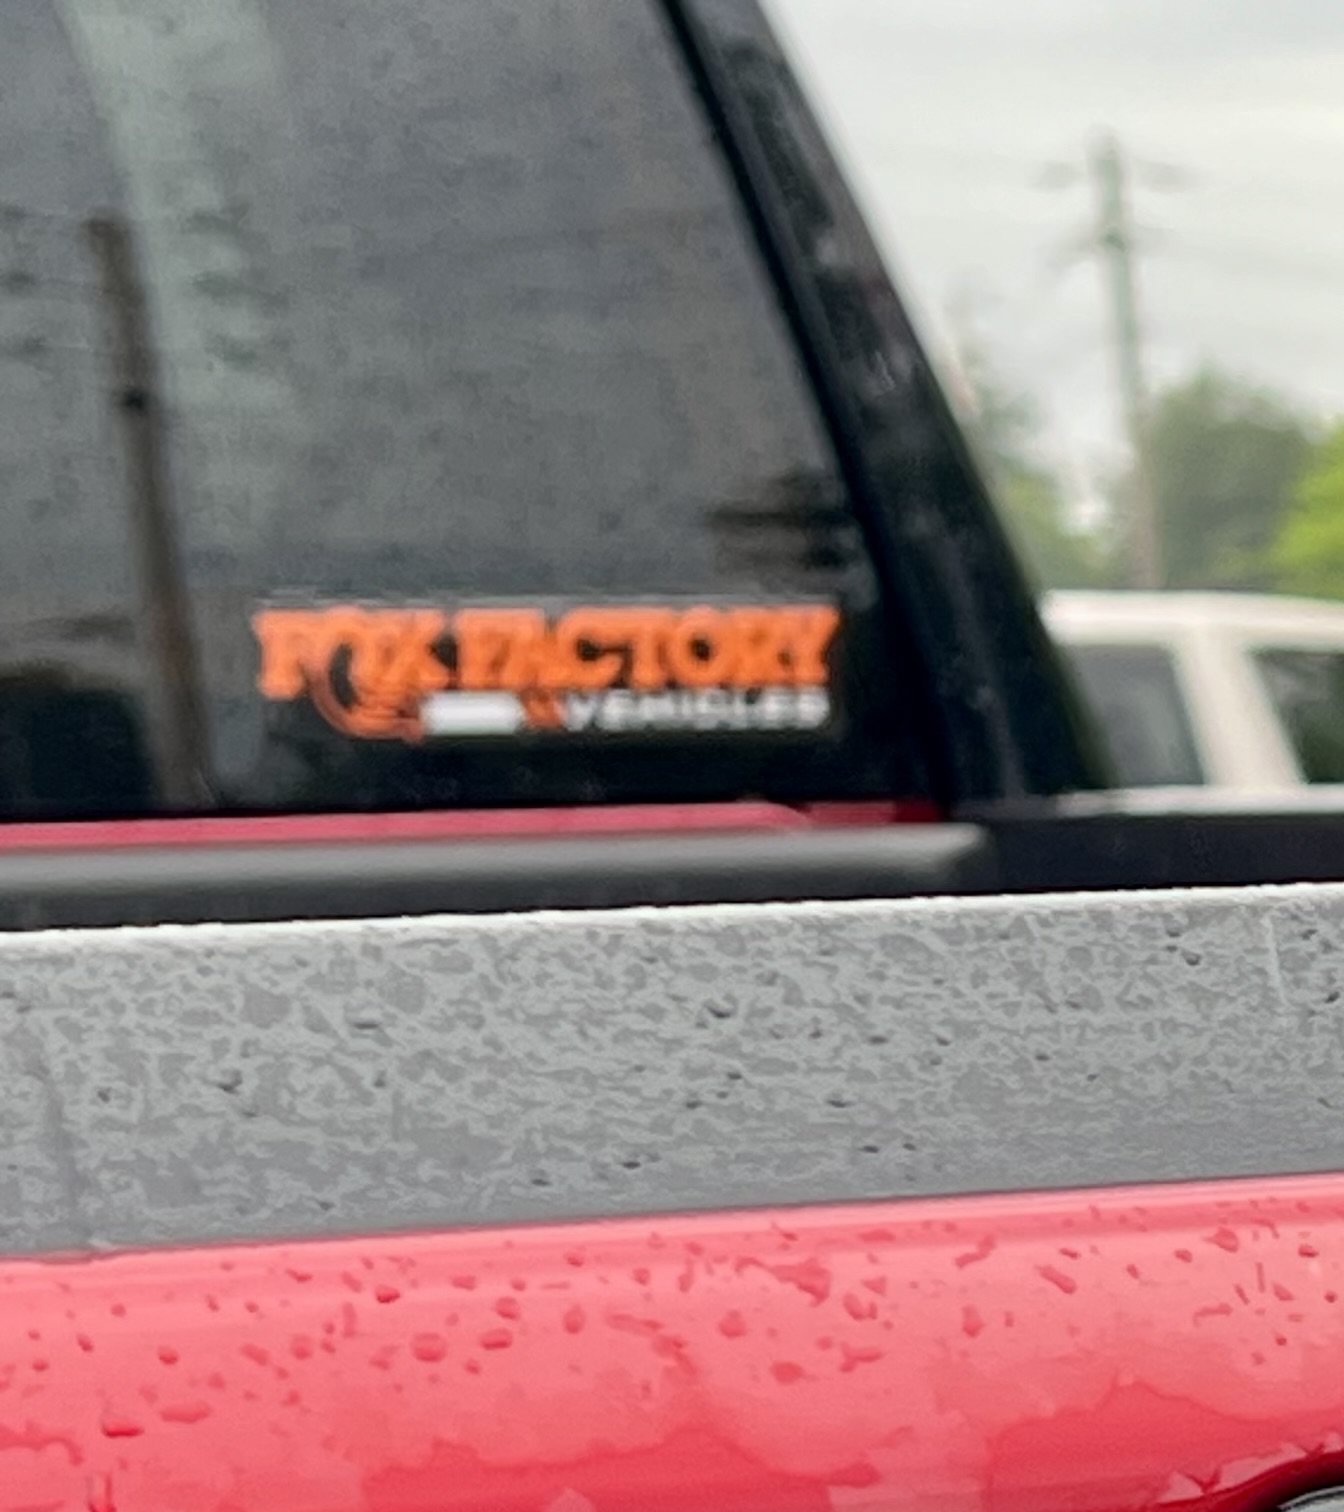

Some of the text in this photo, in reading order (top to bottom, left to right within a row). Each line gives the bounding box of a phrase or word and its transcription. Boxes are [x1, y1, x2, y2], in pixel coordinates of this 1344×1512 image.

[252, 605, 840, 706] FOX FACTORY
[563, 687, 830, 732] VEHICLES
